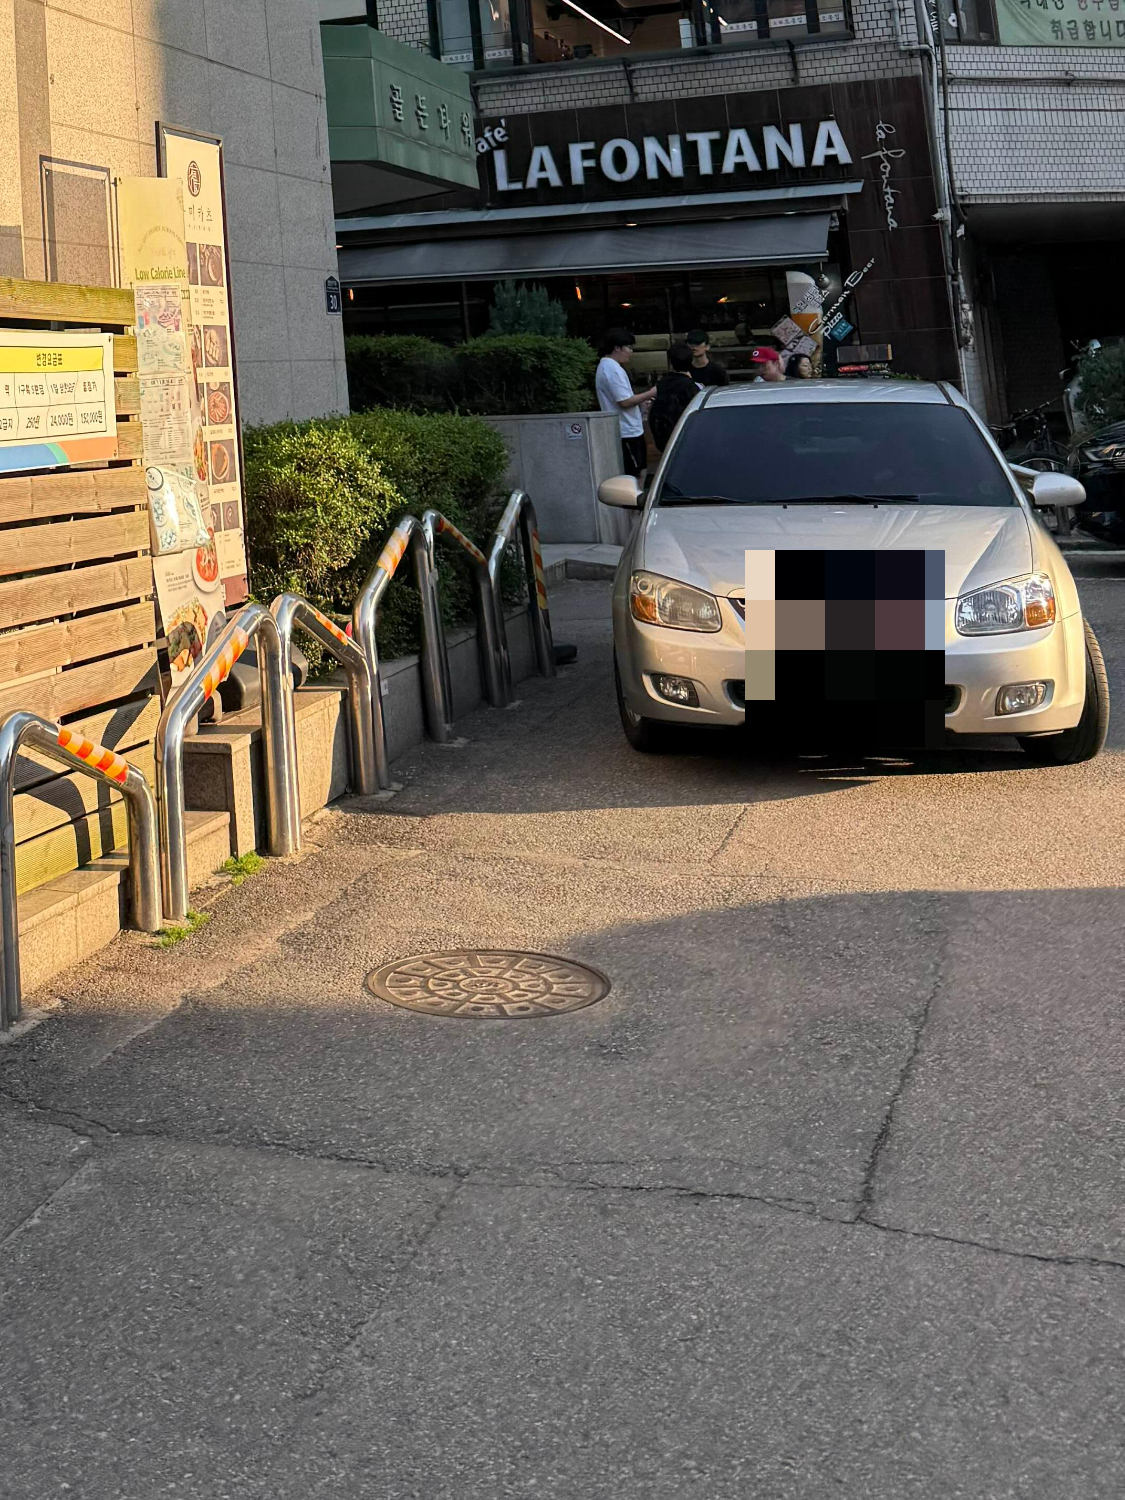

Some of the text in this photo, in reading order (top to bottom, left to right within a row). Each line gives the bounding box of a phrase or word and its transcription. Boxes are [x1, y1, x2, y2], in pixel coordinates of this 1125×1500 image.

[134, 265, 186, 281] Low Calorie Line
